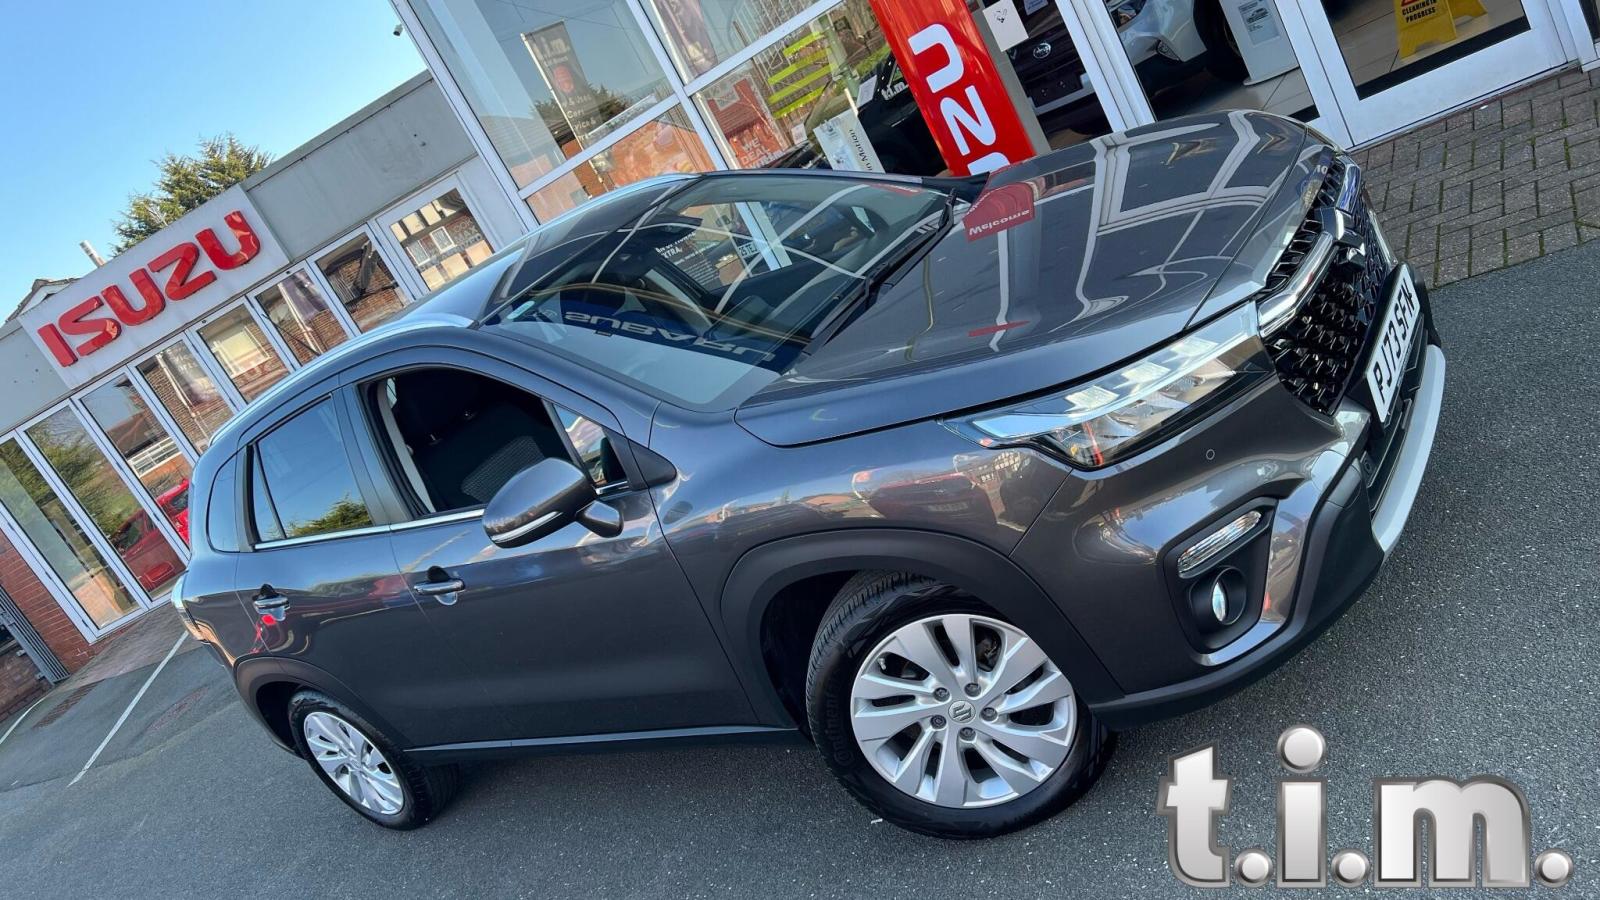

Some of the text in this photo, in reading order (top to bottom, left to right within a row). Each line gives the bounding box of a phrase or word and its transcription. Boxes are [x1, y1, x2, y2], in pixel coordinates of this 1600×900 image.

[1402, 0, 1430, 15] CLEANING
[1406, 7, 1436, 23] PROGRESS
[849, 129, 868, 162] Motion
[37, 210, 261, 368] ISUZU
[1373, 278, 1415, 404] PJ73 SFN
